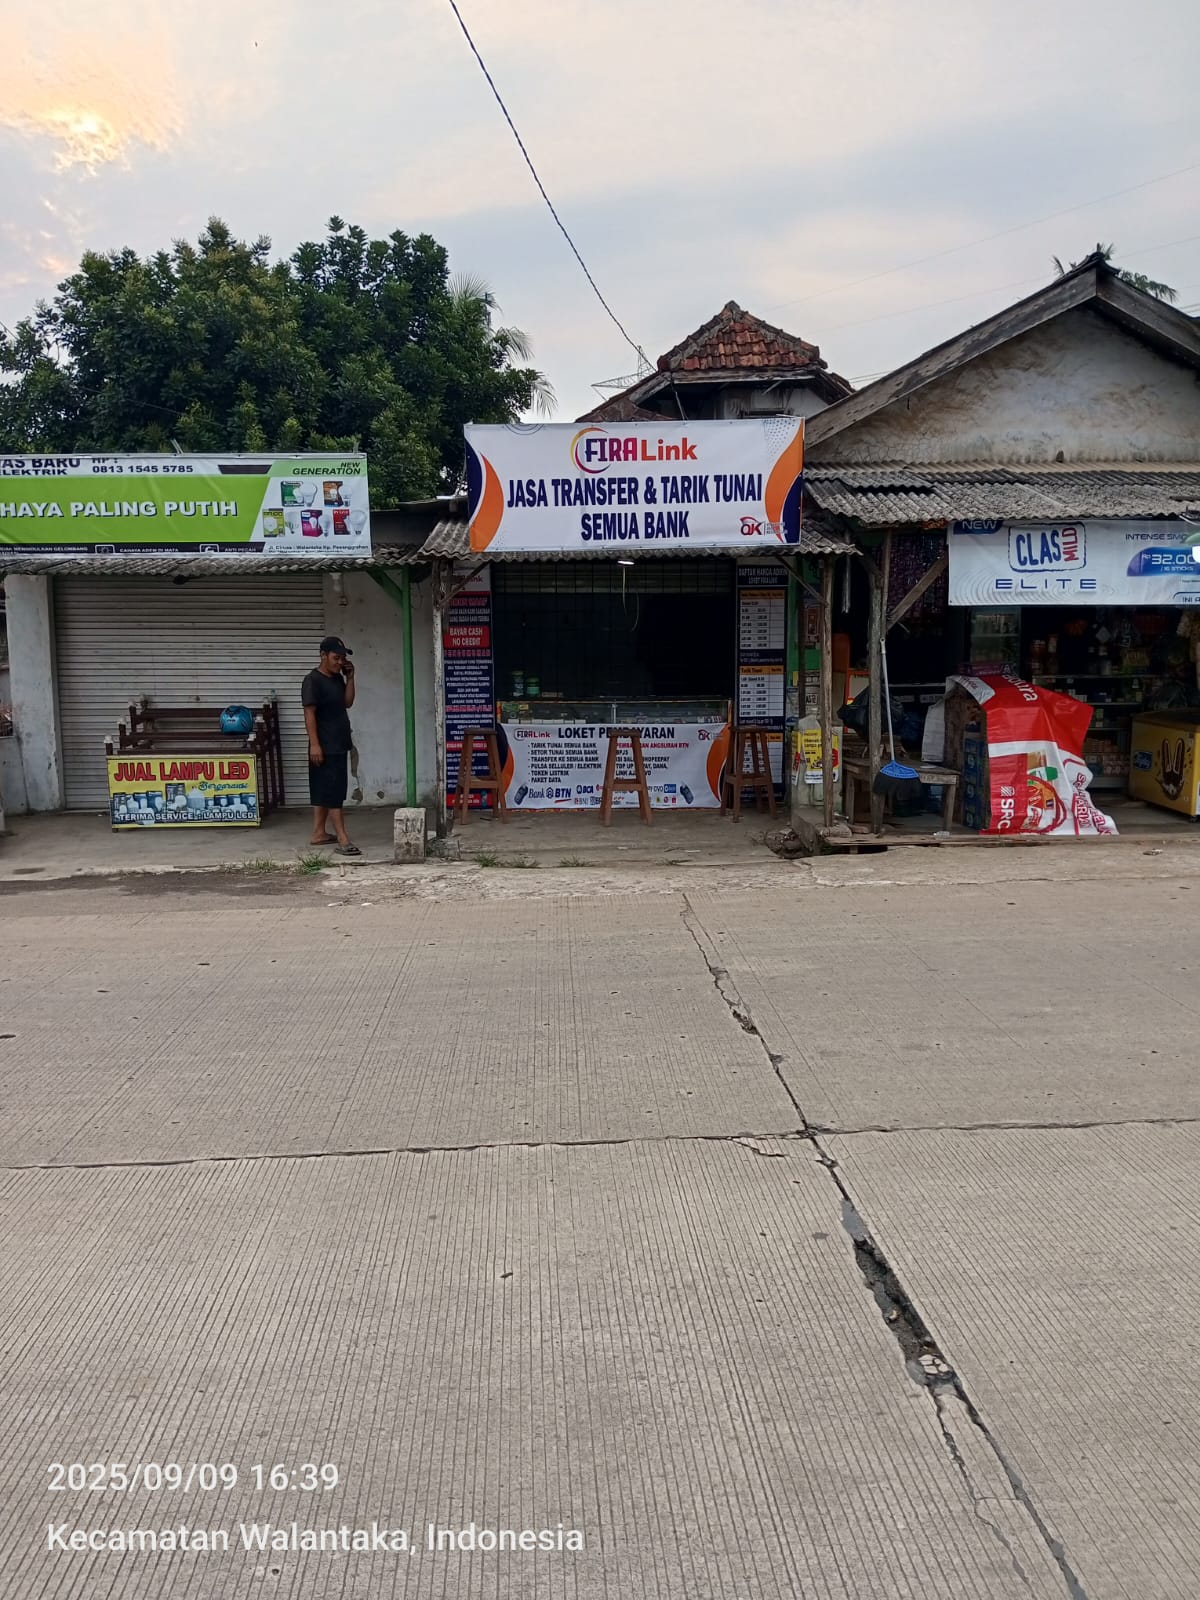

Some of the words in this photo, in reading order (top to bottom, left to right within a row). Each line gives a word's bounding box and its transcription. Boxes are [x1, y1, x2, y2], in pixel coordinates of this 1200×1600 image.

[32, 458, 80, 468] BARU
[508, 479, 548, 508] JASA
[552, 476, 640, 506] TRANSFER
[644, 476, 657, 504] &
[660, 474, 710, 504] TARIK
[714, 474, 762, 502] TUNAI
[0, 502, 64, 518] HAYA
[70, 501, 158, 517] PALING
[164, 500, 238, 516] PUTIH
[581, 512, 640, 541] SEMUA
[644, 510, 690, 540] BANK
[962, 520, 997, 530] NEW
[1016, 530, 1062, 566] CLAS
[1062, 528, 1080, 562] MILD
[996, 578, 1096, 590] ELITE
[468, 628, 483, 636] CASH
[558, 728, 595, 738] LOKET
[114, 762, 156, 782] JUAL
[160, 762, 214, 780] LAMPU
[219, 762, 250, 780] LED
[528, 788, 545, 799] Bank
[555, 788, 572, 798] BTN
[998, 798, 1015, 829] SRC
